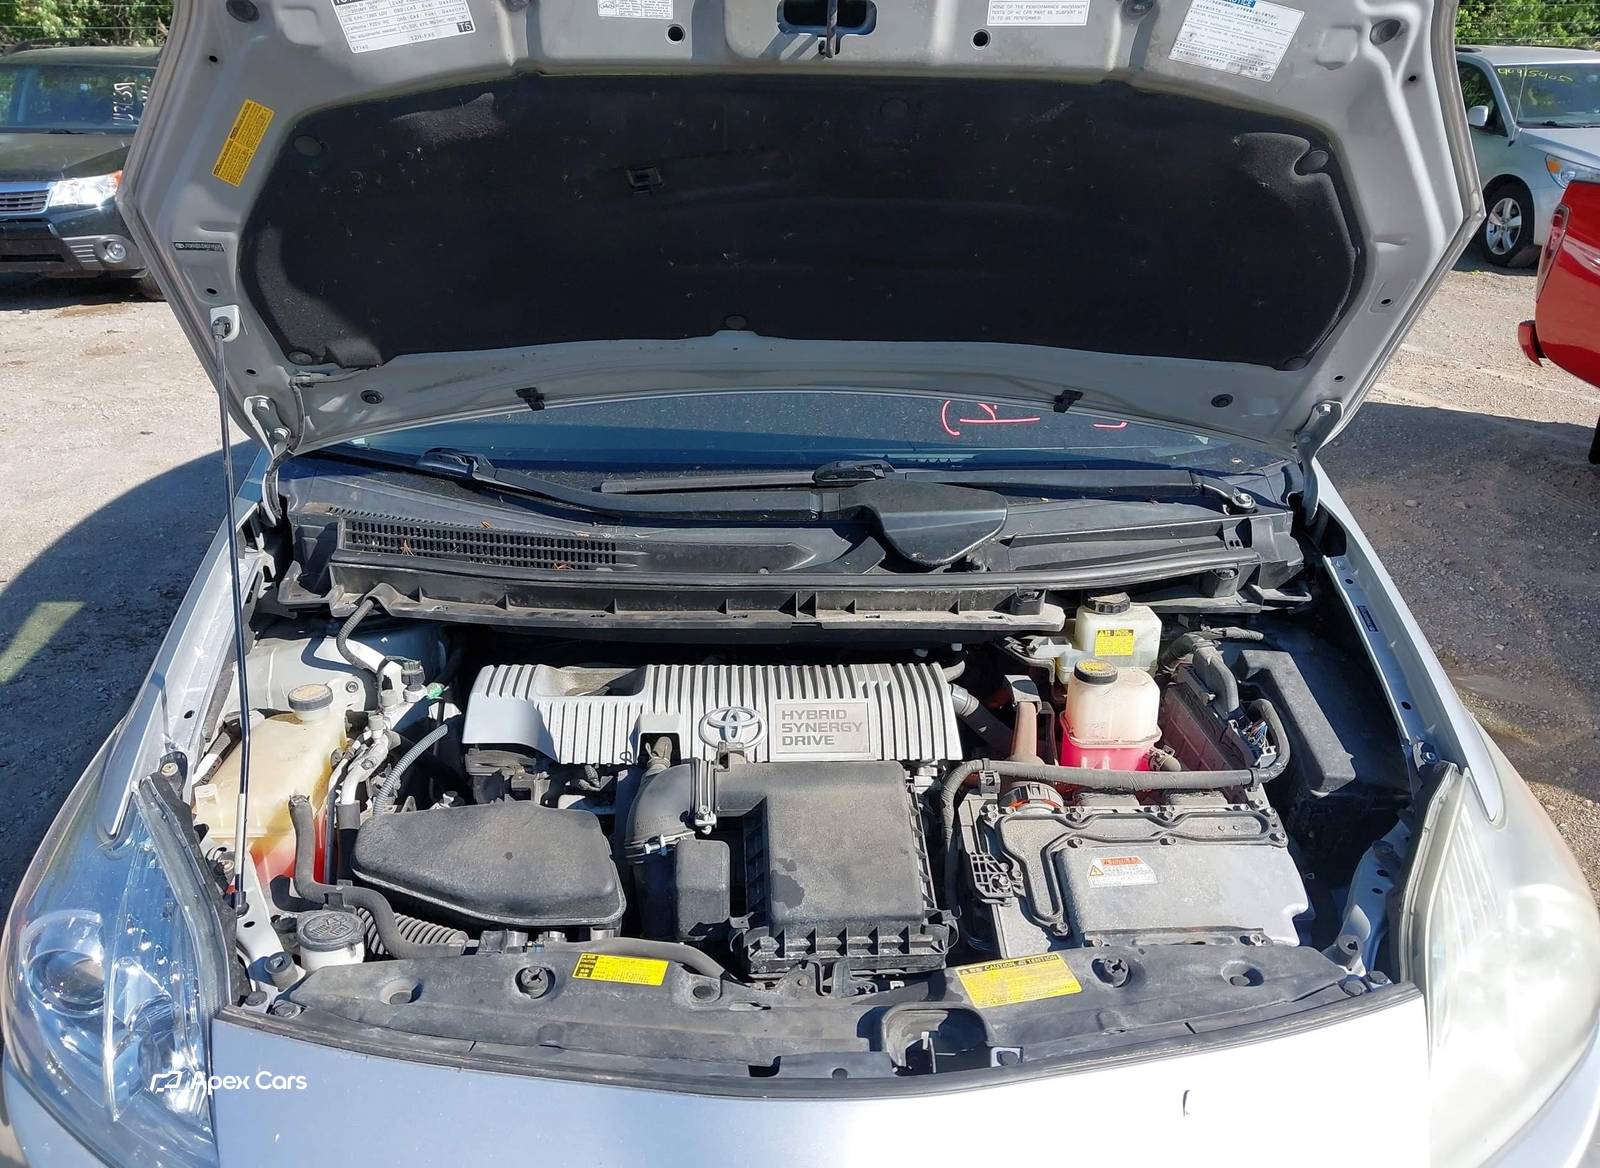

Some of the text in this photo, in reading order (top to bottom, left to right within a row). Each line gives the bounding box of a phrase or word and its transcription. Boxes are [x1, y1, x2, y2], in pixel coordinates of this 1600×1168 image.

[458, 22, 472, 32] T5
[781, 710, 848, 720] HYBRID
[781, 722, 864, 733] SYNERGY
[782, 735, 835, 746] DRIVE
[984, 961, 1016, 971] CAUTION
[1018, 954, 1058, 966] ATTENTION
